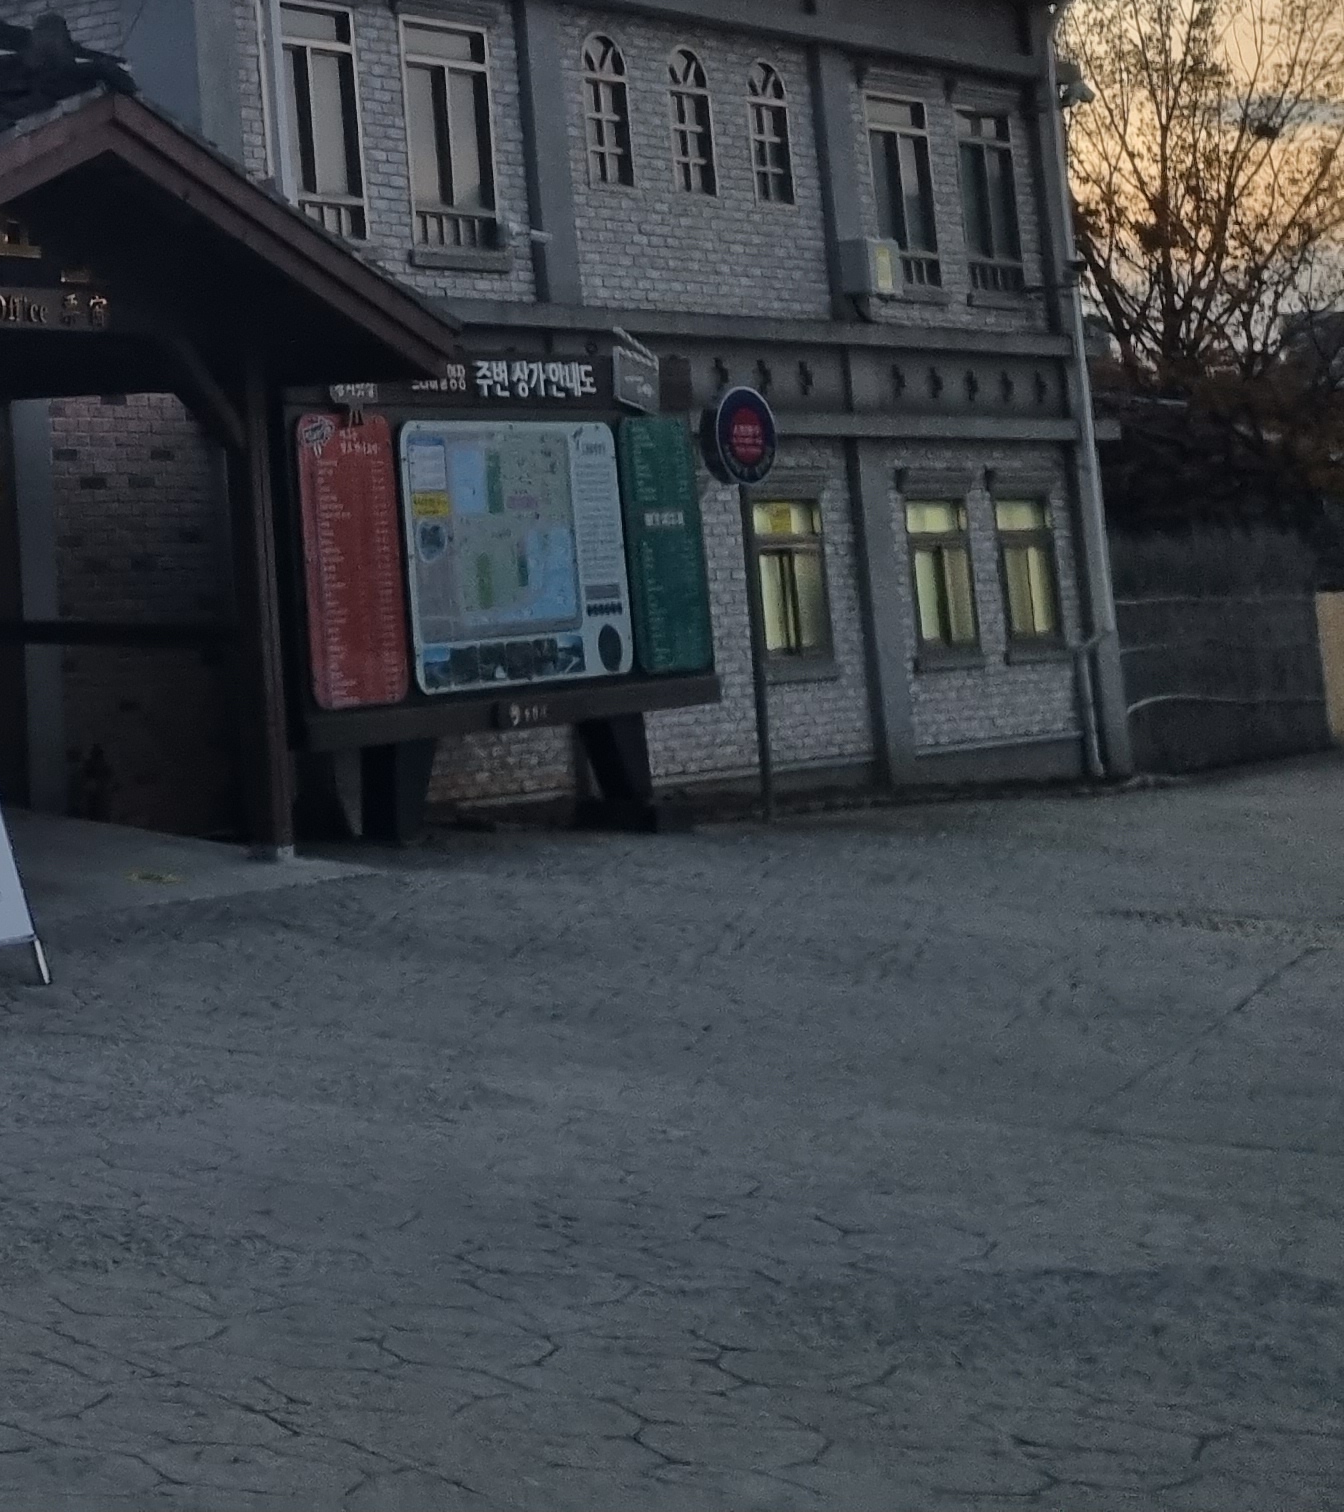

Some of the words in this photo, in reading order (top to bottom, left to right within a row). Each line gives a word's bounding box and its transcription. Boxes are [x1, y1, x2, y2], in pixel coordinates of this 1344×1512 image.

[472, 359, 511, 398] 주변
[511, 360, 546, 398] 상가
[545, 361, 598, 399] 안내도
